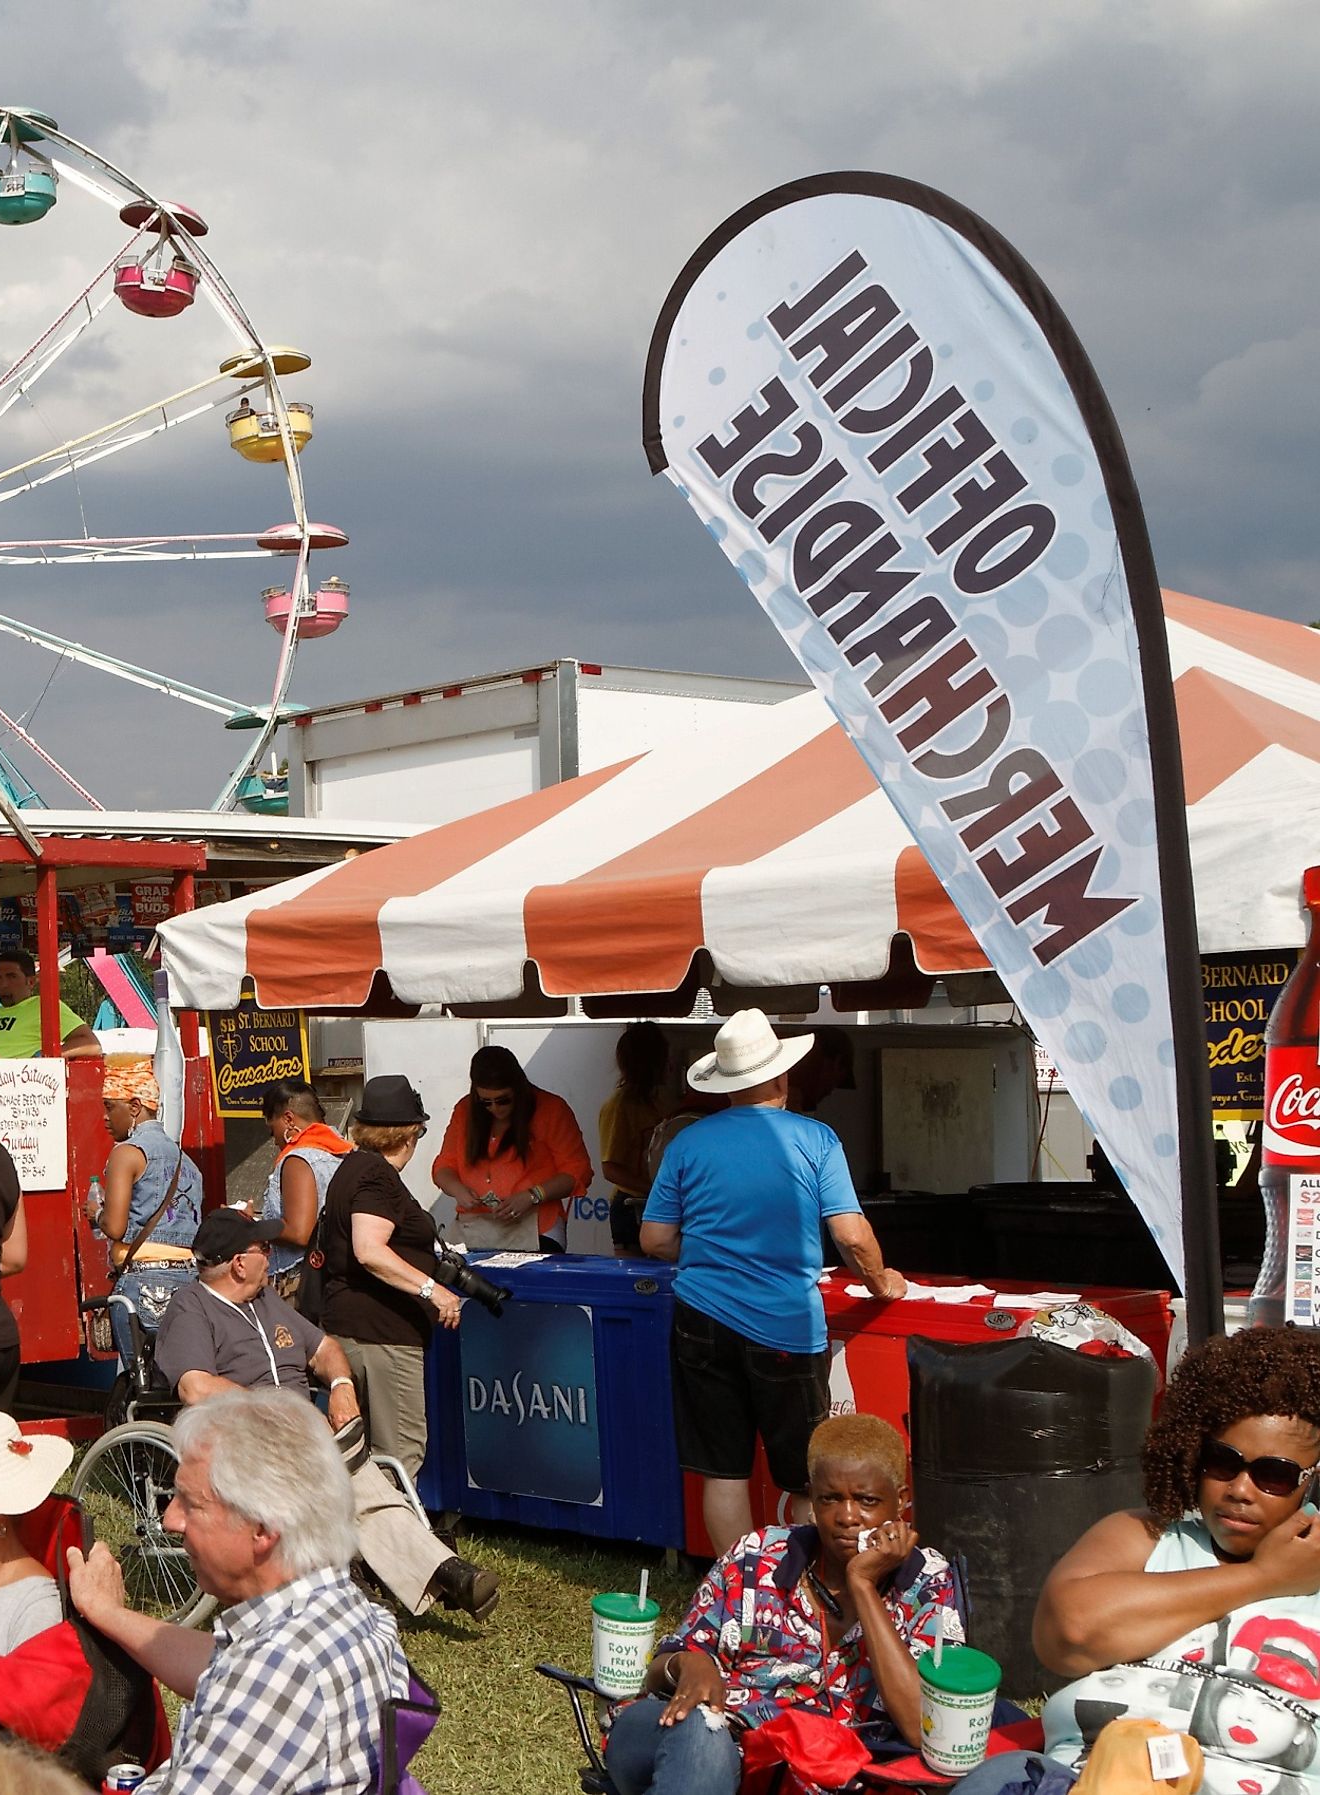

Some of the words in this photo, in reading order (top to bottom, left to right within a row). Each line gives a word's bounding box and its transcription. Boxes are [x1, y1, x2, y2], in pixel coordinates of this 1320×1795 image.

[135, 886, 170, 896] GRAB
[135, 903, 170, 914] BUDS
[1203, 998, 1268, 1023] CHOOL
[220, 1018, 236, 1033] SB
[252, 1011, 295, 1029] BERNARD
[249, 1034, 288, 1052] SCHOOL
[218, 1055, 303, 1095] Crusaders
[1236, 1072, 1257, 1083] Est.
[1, 1132, 39, 1154] Sunday
[468, 1370, 587, 1426] DASANI
[608, 1642, 639, 1656] ROY'S
[611, 1657, 636, 1667] FRESH
